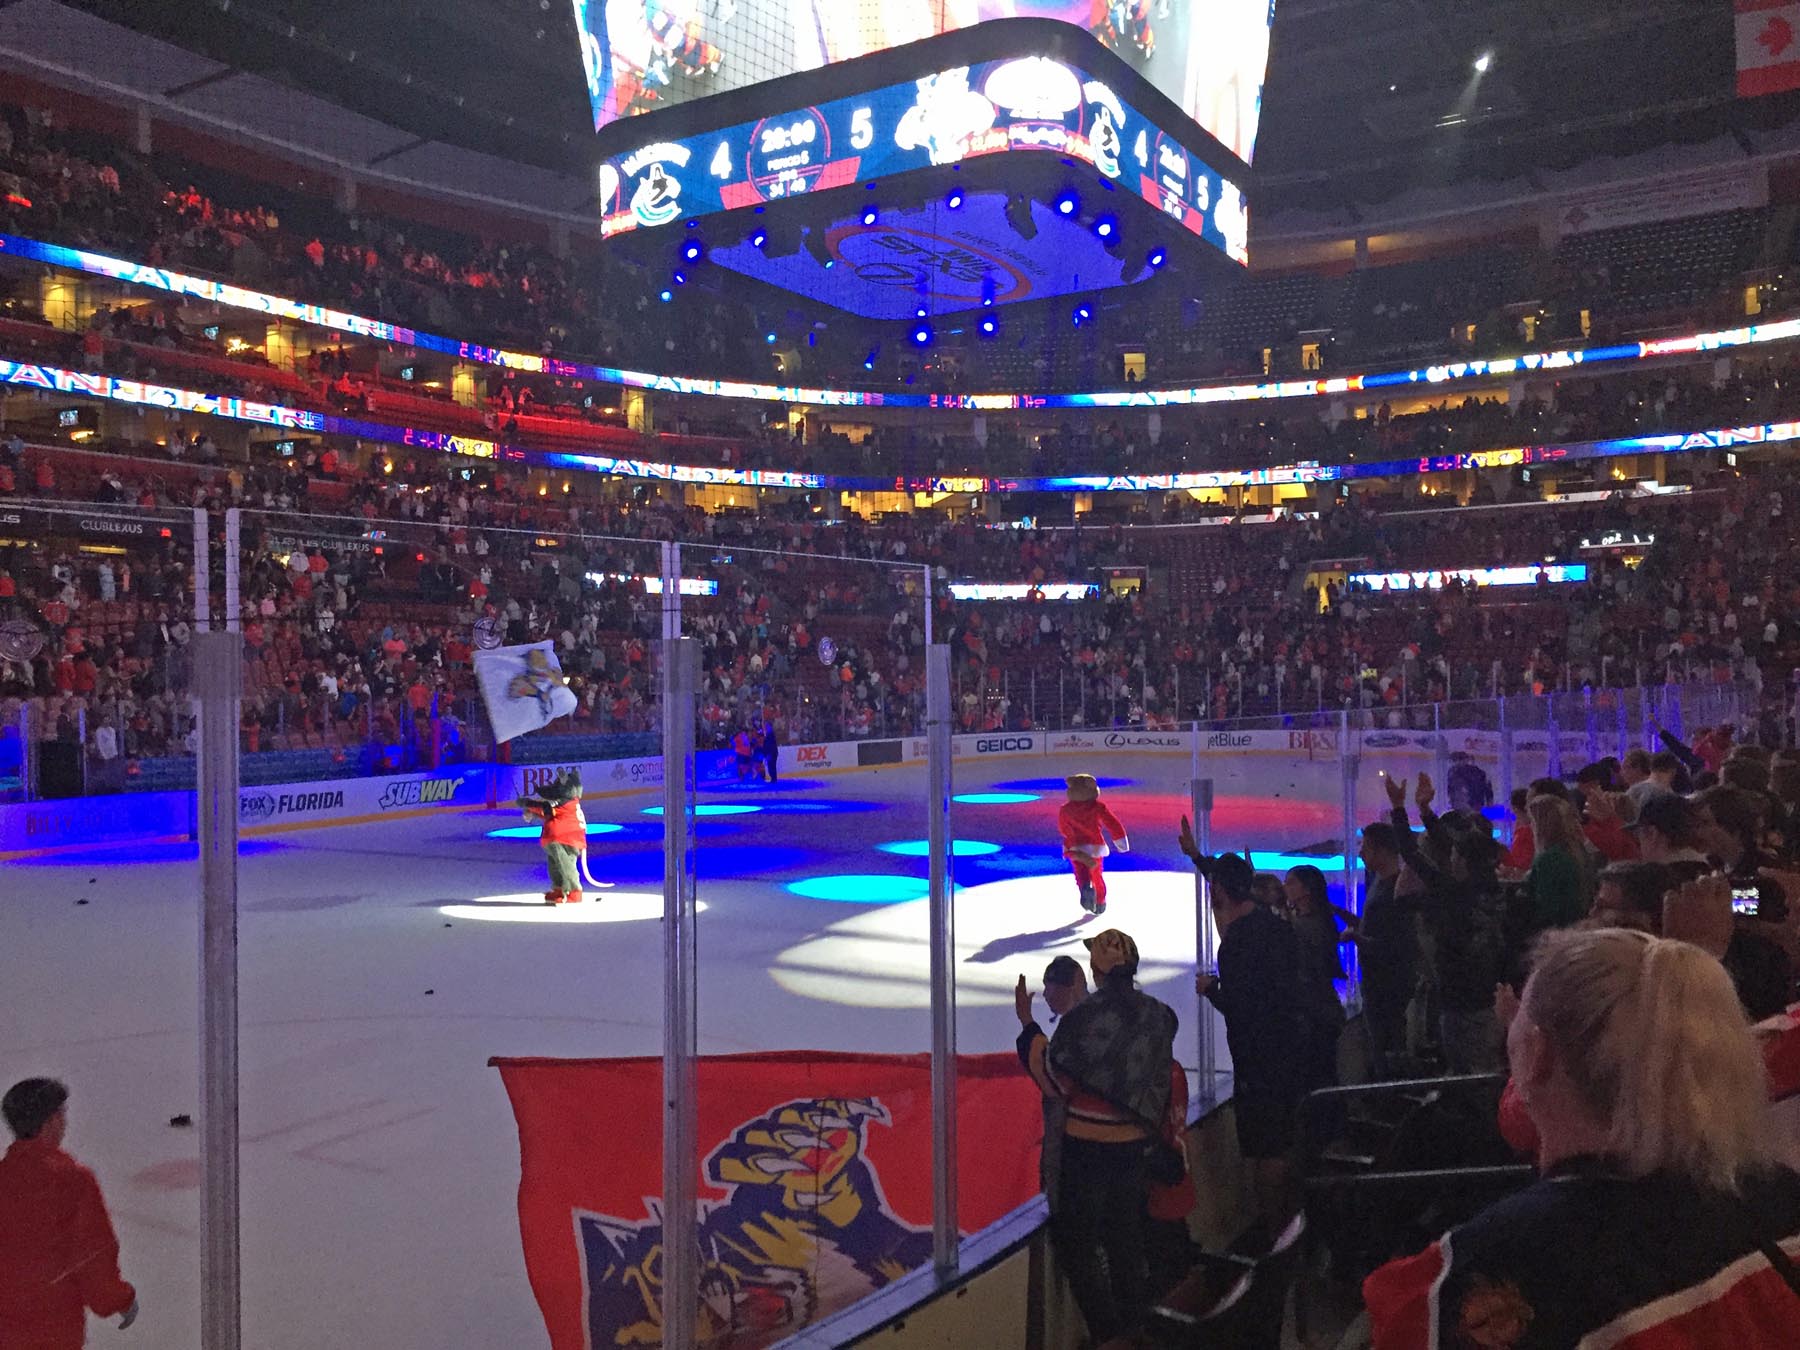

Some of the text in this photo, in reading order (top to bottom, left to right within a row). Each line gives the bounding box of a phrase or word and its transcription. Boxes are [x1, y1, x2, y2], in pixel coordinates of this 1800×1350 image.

[850, 107, 874, 150] 5
[709, 141, 733, 179] 4
[1134, 129, 1148, 168] 4
[1197, 175, 1209, 211] 5
[797, 745, 828, 763] DEX
[976, 737, 1033, 753] GEICO
[1207, 732, 1252, 749] jetBlue
[278, 790, 344, 814] FLORIDA
[378, 776, 465, 811] SUBWAY
